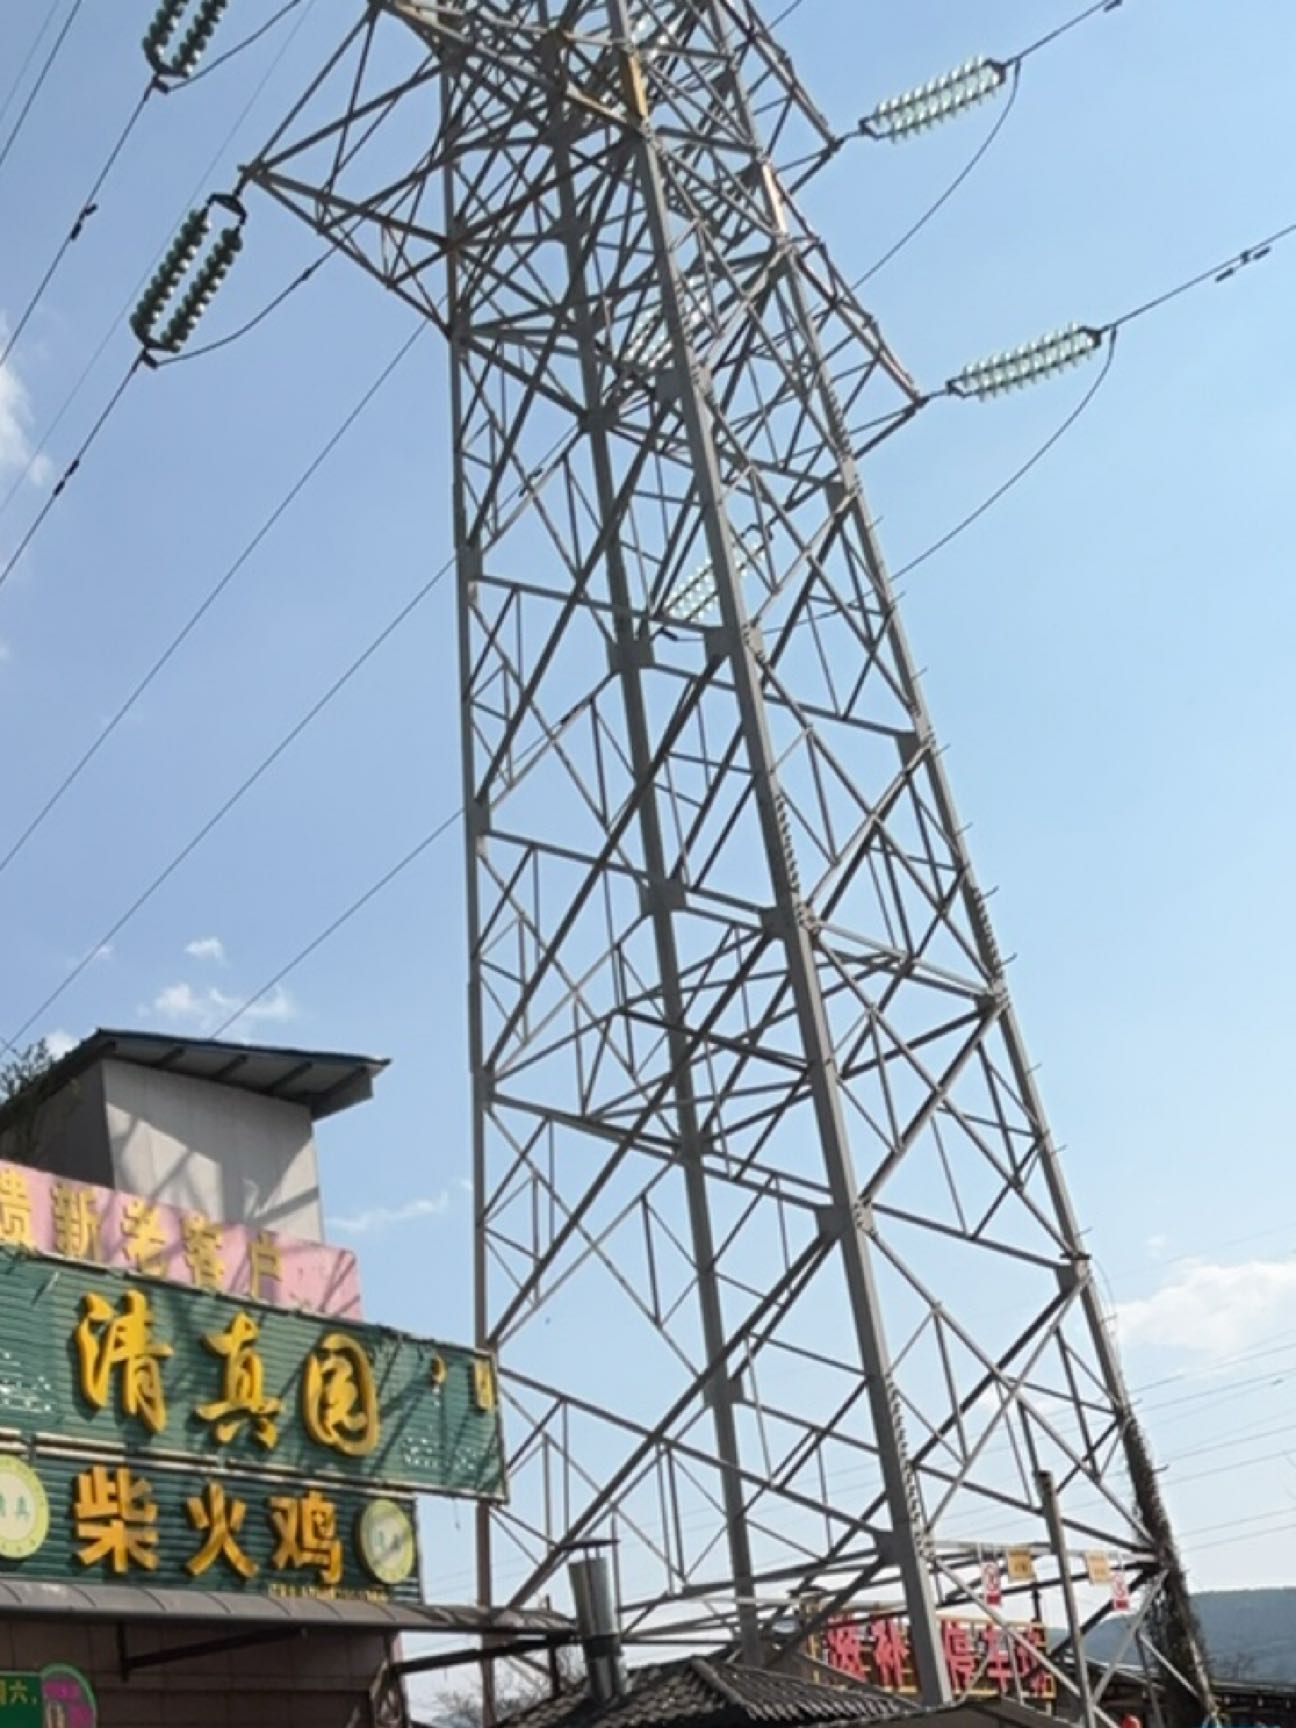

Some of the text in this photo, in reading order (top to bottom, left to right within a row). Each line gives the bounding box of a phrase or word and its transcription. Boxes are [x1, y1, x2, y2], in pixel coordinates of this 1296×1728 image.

[75, 1289, 380, 1456] 清真园
[74, 1464, 342, 1585] 柴火鸡
